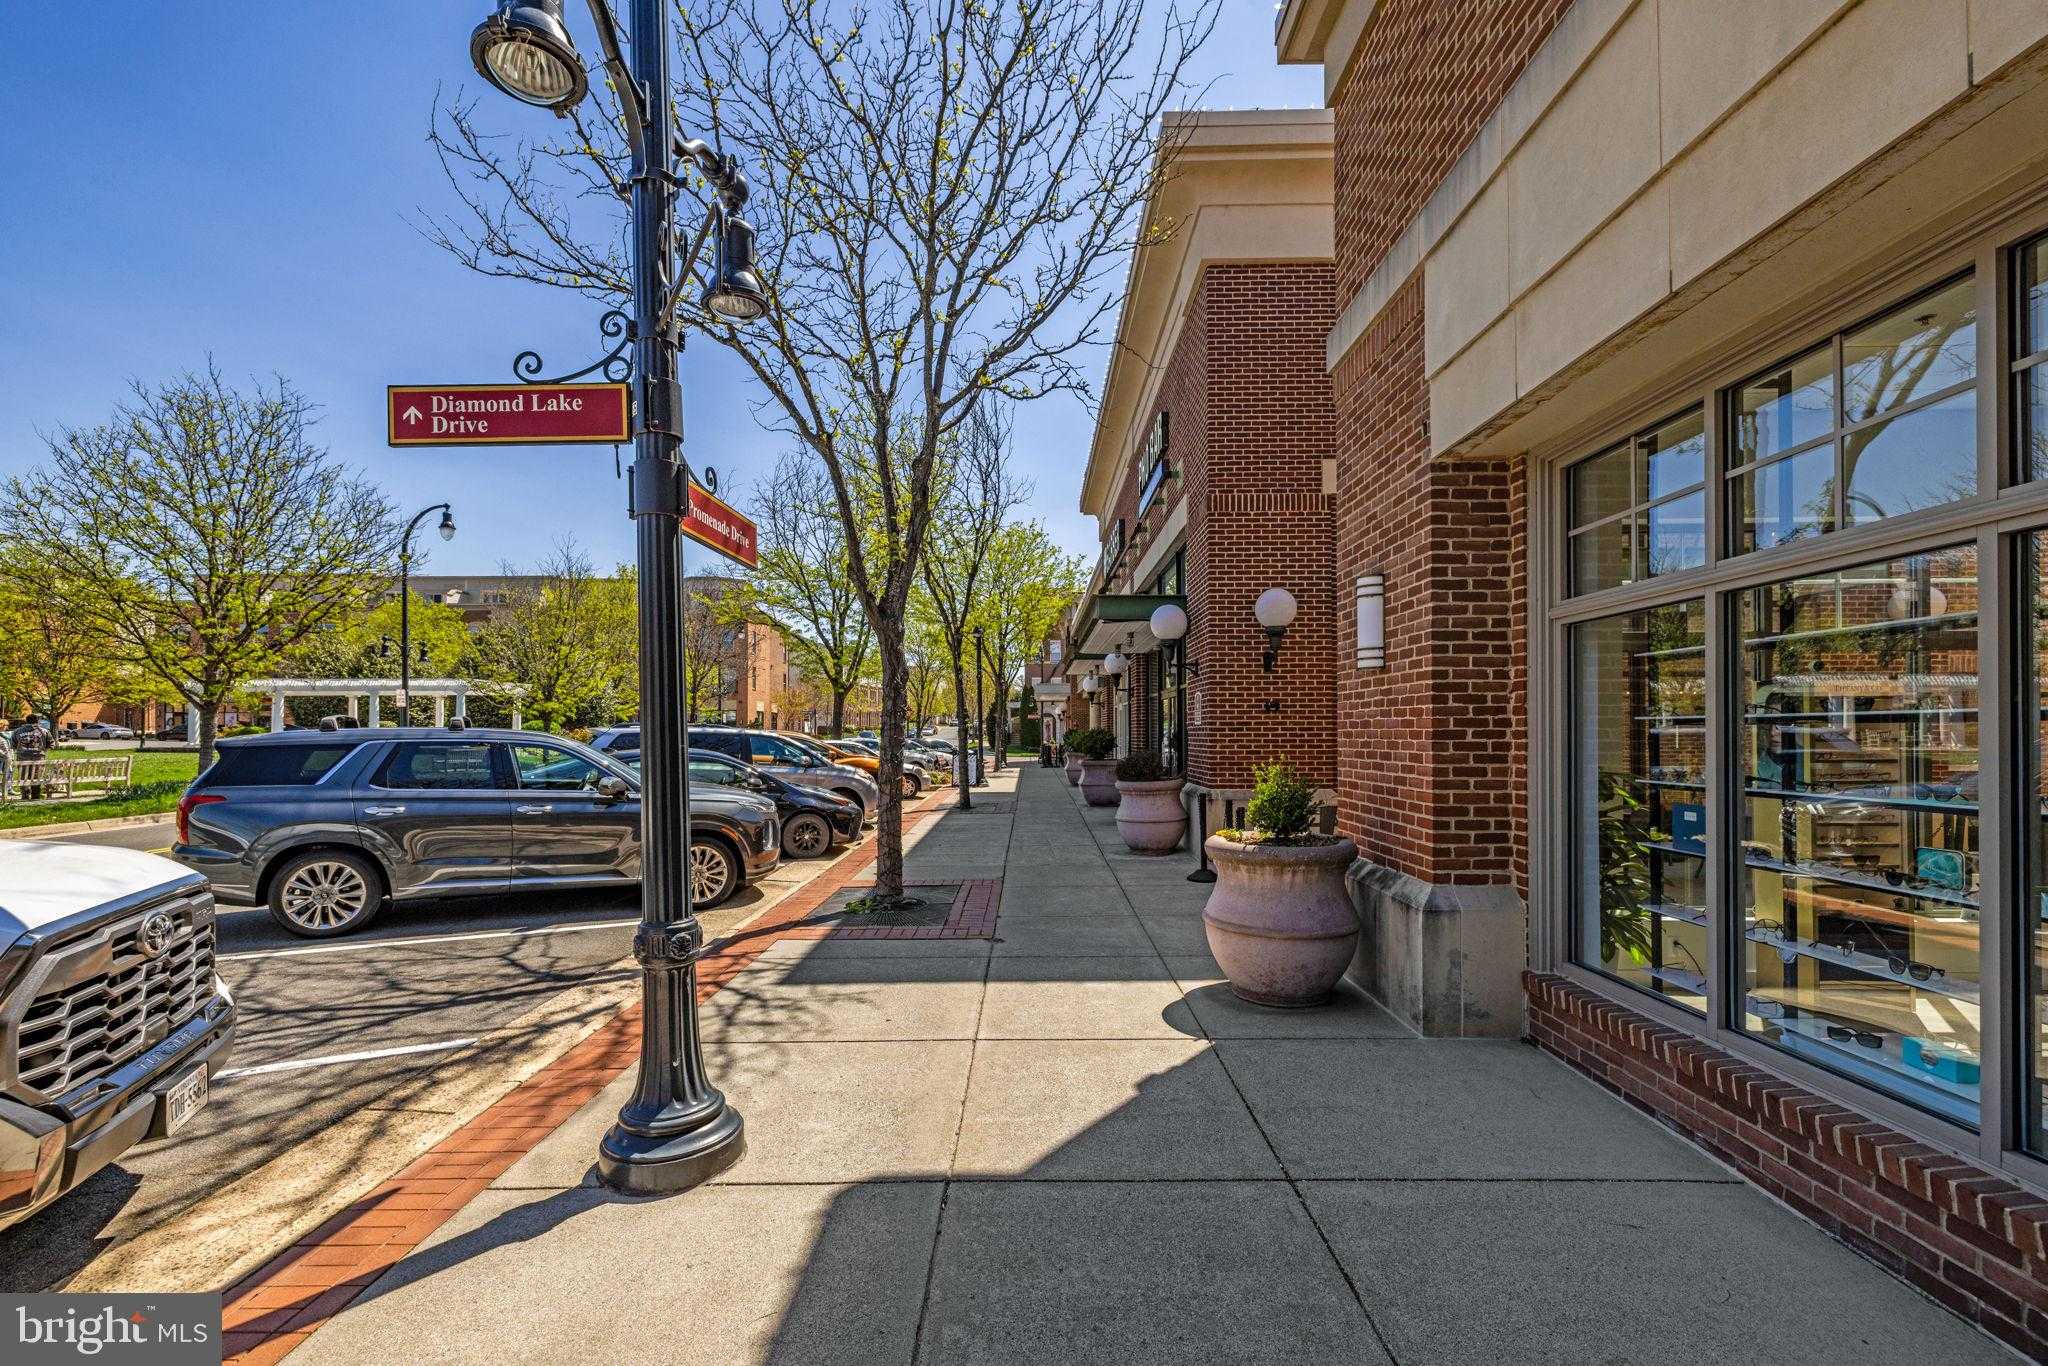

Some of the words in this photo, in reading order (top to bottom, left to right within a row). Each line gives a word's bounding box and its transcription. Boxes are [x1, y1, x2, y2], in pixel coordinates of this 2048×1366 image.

[431, 395, 524, 413] Diamond
[531, 394, 583, 412] Lake
[431, 416, 489, 433] Drive
[688, 499, 731, 537] Promenade
[731, 526, 750, 548] Drive
